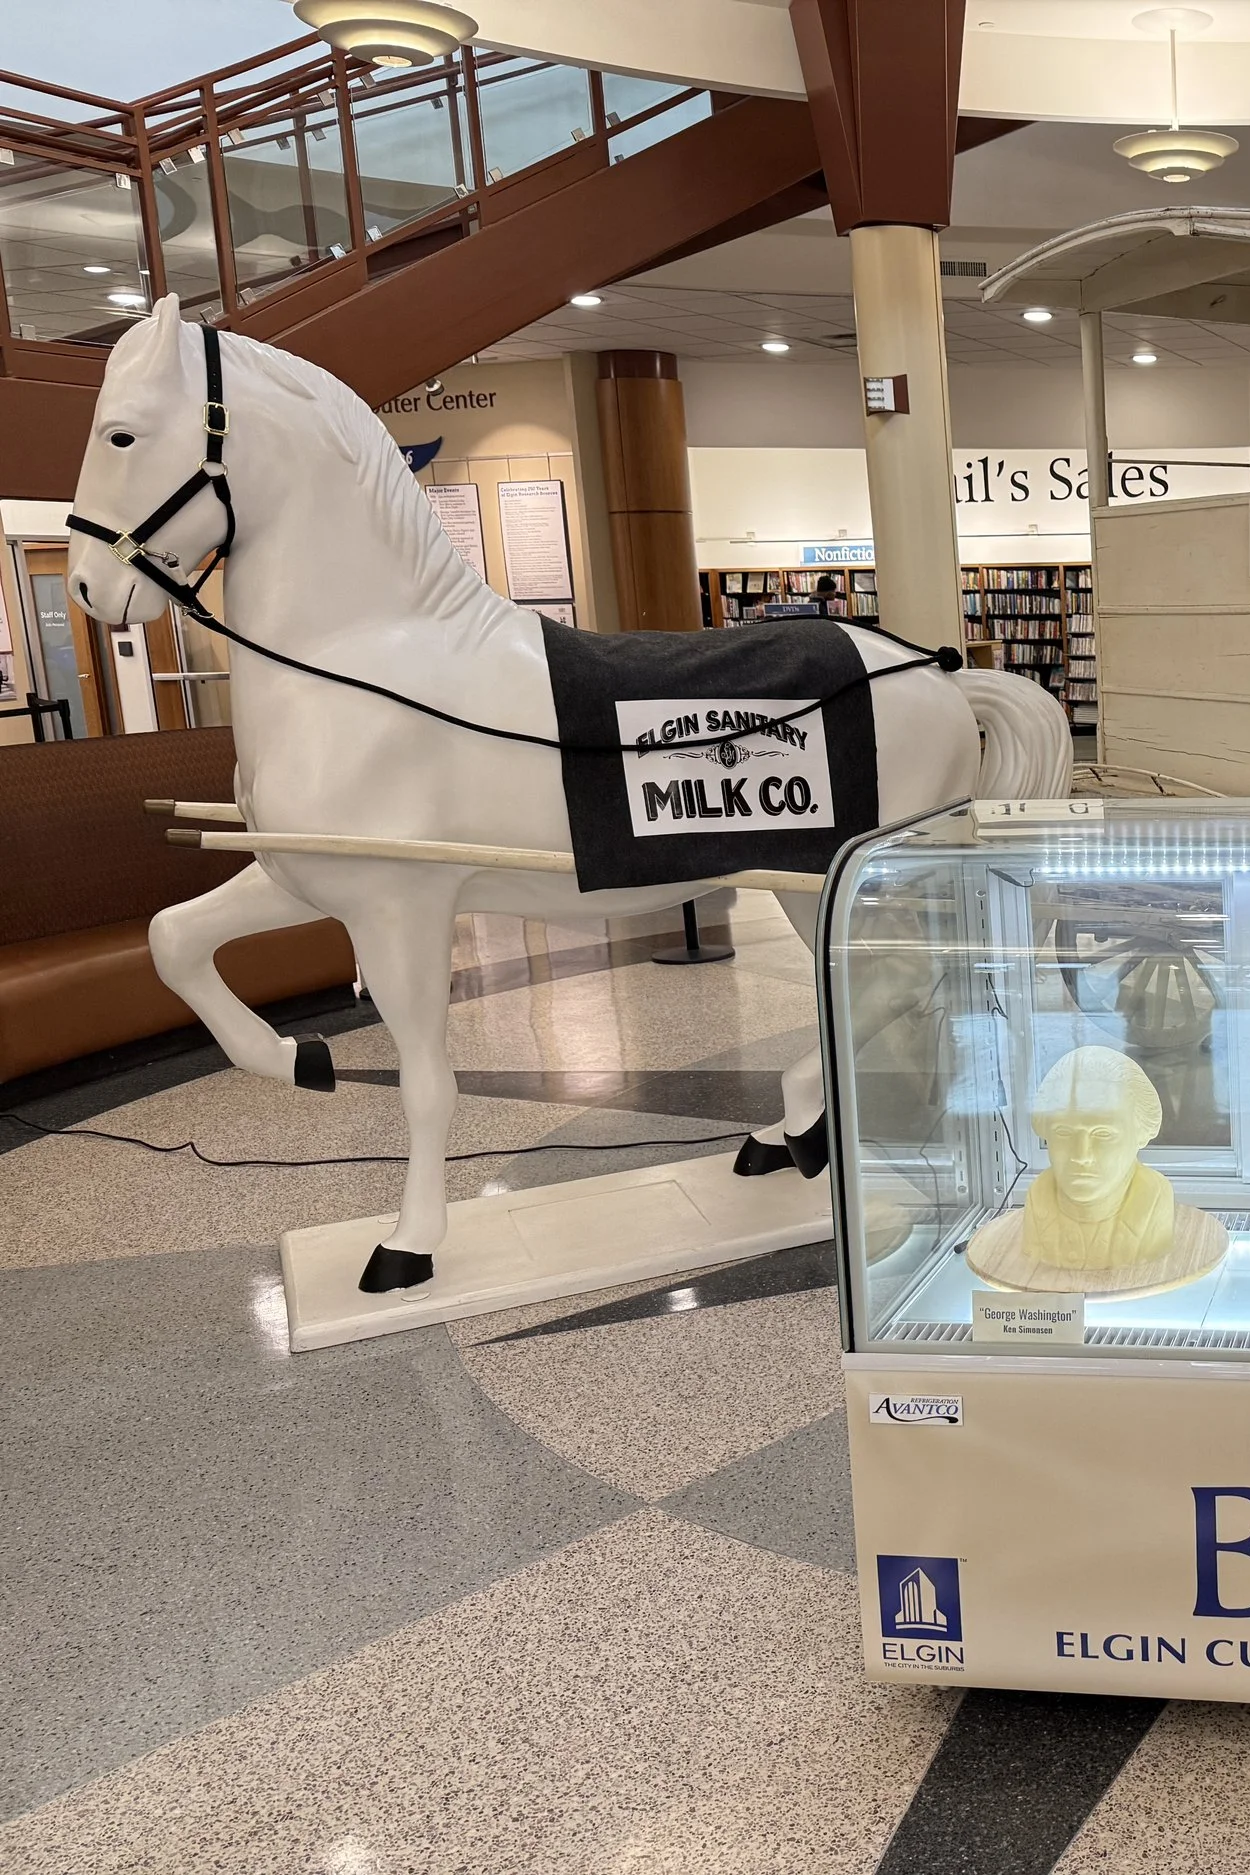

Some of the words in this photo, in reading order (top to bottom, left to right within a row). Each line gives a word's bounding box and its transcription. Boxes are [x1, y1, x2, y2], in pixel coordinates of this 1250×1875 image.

[426, 390, 496, 411] Center
[402, 450, 413, 464] 6
[1050, 451, 1169, 500] Sales
[54, 611, 66, 620] Only
[635, 713, 700, 758] ELGIN
[705, 710, 808, 750] SANITARY
[642, 777, 753, 822] MILK
[758, 776, 819, 817] CO.
[1003, 1325, 1016, 1333] Ken
[1018, 1325, 1053, 1334] Simonsen
[872, 1397, 959, 1423] AVANTCO
[882, 1642, 964, 1664] ELGIN
[1054, 1631, 1187, 1665] ELGIN
